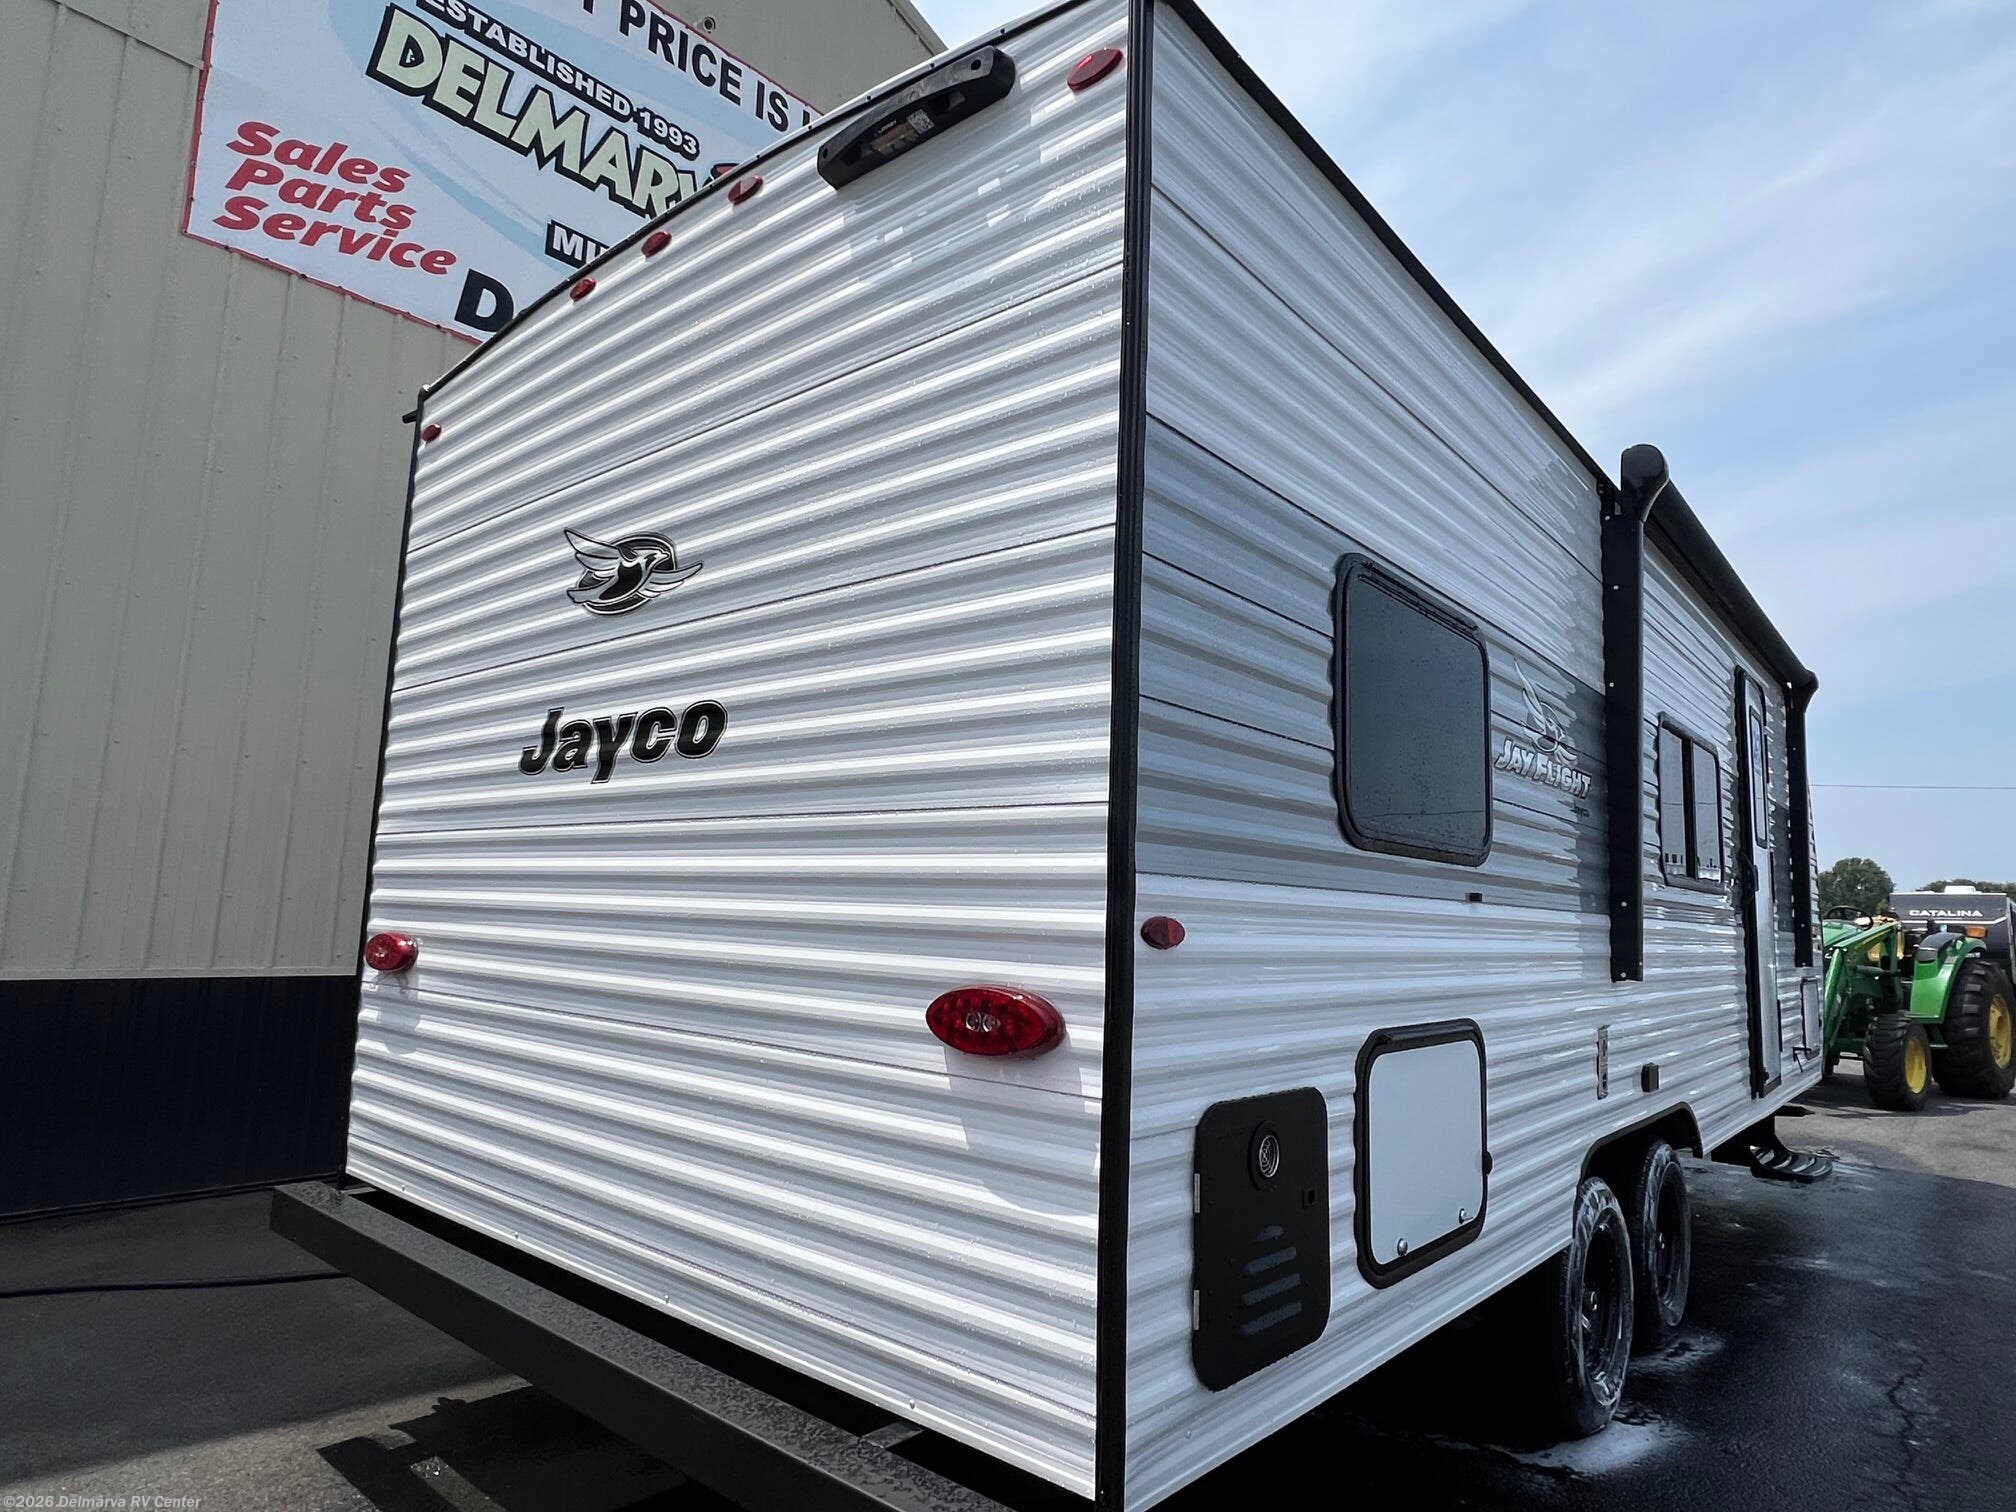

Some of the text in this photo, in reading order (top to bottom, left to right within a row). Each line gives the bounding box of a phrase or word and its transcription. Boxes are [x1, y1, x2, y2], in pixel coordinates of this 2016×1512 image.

[619, 0, 789, 132] PRICE IS
[226, 121, 411, 193] Sales
[639, 108, 699, 157] 1993
[225, 158, 417, 230] Parts
[212, 196, 457, 275] Service
[519, 700, 728, 784] Jayco
[1494, 738, 1591, 798] JAY FLIGHT
[1909, 909, 1983, 917] CATALINA
